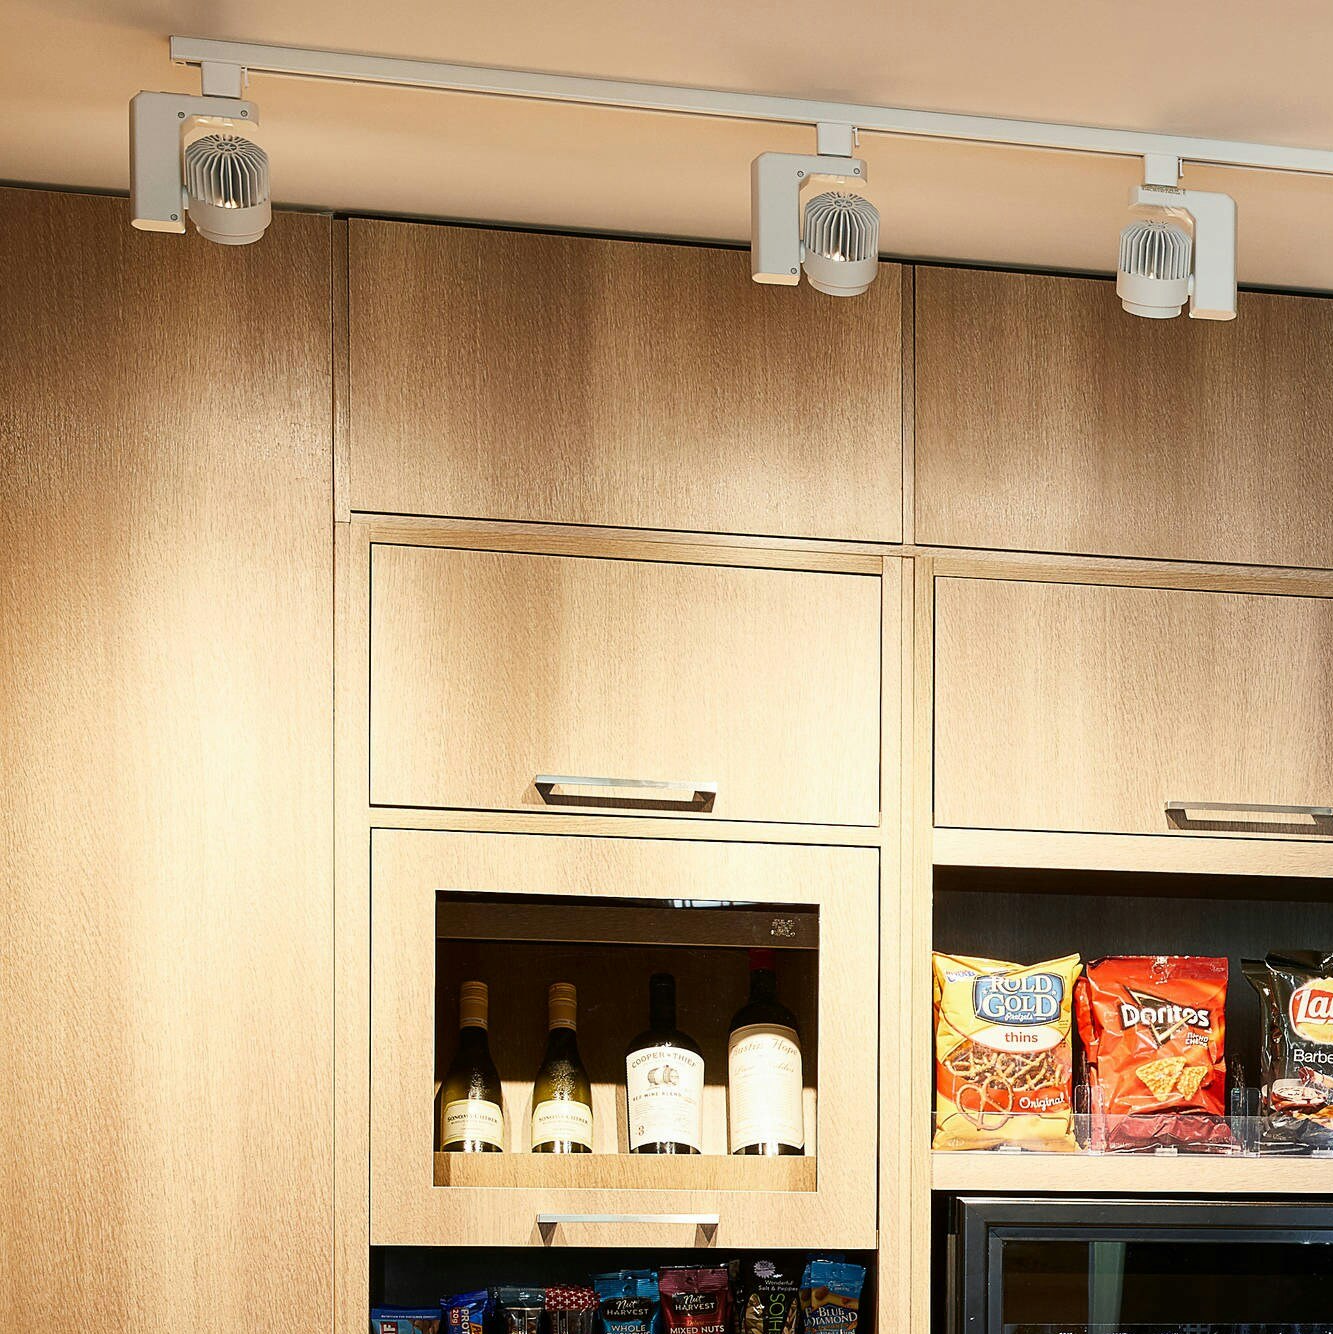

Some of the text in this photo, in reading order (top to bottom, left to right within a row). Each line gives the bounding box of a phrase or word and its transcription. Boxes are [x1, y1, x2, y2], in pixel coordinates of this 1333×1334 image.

[989, 975, 1052, 994] ROLD
[982, 994, 1058, 1018] GOLD
[1119, 1004, 1210, 1028] Doritos
[1004, 1032, 1038, 1043] thins
[631, 1051, 665, 1069] COOPER
[1019, 1092, 1065, 1111] Original
[616, 1300, 637, 1309] Nut
[683, 1294, 706, 1304] Nut
[606, 1308, 649, 1316] HARVEST
[675, 1302, 715, 1312] HARVEST
[670, 1325, 725, 1334] MIXED NUTS
